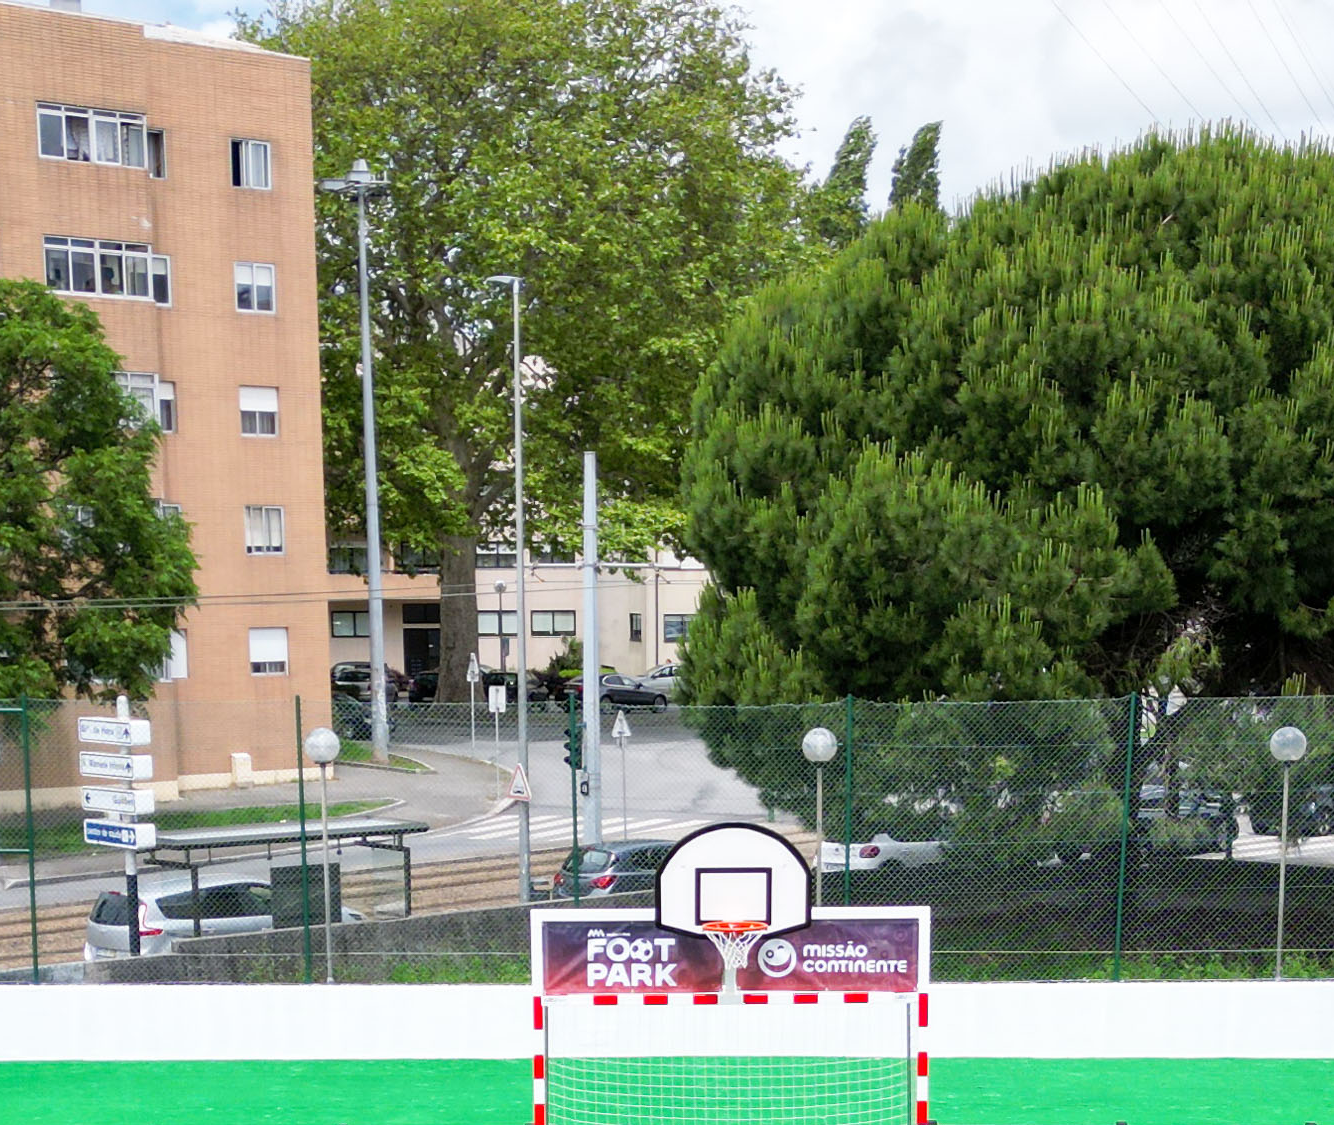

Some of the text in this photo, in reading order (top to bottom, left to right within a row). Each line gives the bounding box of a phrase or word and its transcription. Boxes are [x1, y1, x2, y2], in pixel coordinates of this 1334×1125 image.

[802, 941, 867, 958] MISSÃO
[802, 959, 908, 973] CONTINENTE
[587, 963, 678, 987] PARK
